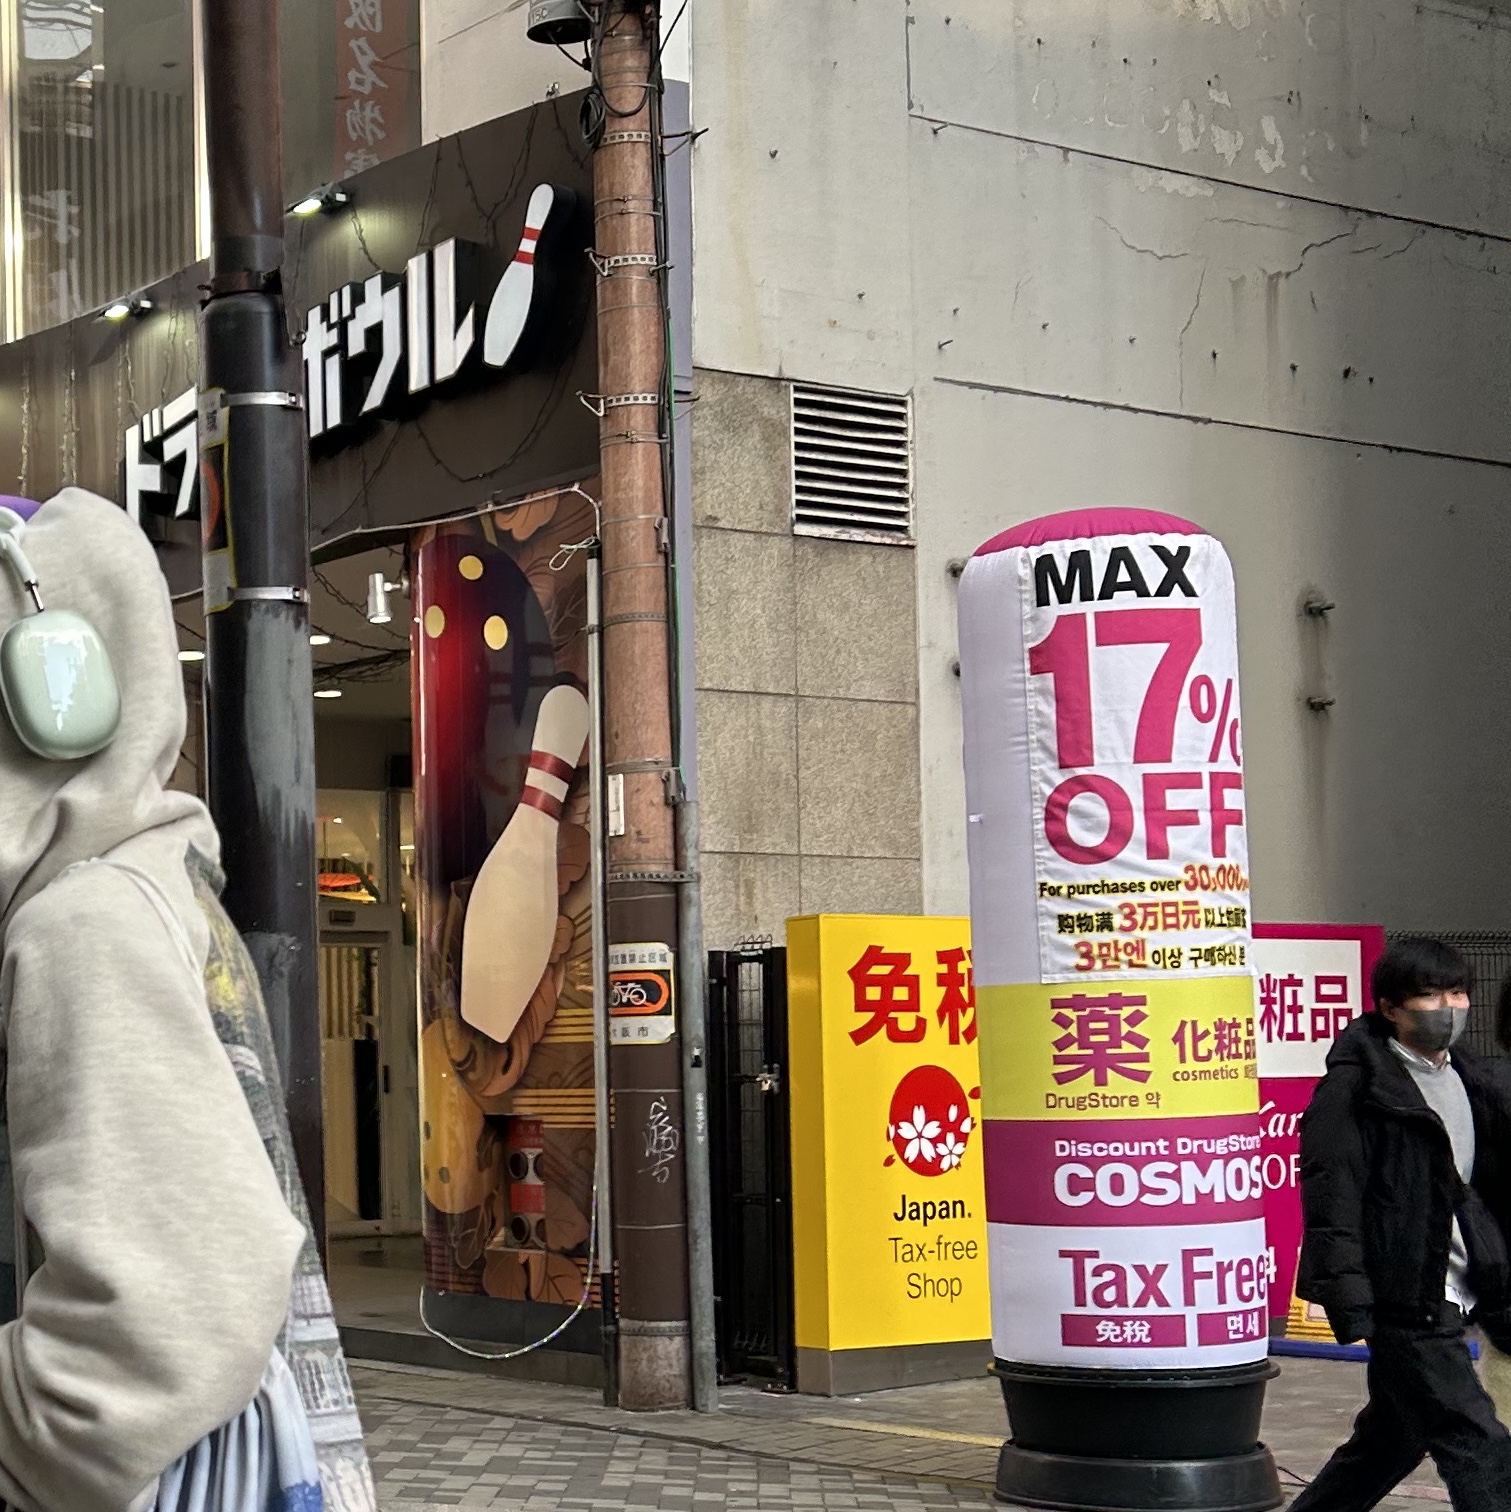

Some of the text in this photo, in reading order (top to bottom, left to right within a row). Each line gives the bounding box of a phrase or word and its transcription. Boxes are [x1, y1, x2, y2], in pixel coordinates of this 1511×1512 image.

[1034, 545, 1200, 608] MAX
[1044, 771, 1244, 866] OFF
[1039, 881, 1063, 897] For
[1067, 879, 1146, 899] purchases
[1150, 879, 1183, 893] over
[1073, 938, 1148, 971] 3만엔
[1151, 948, 1183, 969] 이상
[1050, 991, 1153, 1088] 薬
[1172, 1064, 1239, 1082] cosmetics
[1045, 1092, 1140, 1111] DrugStore
[1145, 1091, 1162, 1109] 약
[1054, 1132, 1261, 1158] Discount DrugStore
[1053, 1156, 1263, 1207] COSMOS
[893, 1194, 973, 1228] Japan.
[888, 1234, 979, 1264] Tax-free
[906, 1271, 963, 1303] Shop
[1058, 1248, 1171, 1309] Tax
[1181, 1246, 1266, 1308] Free
[1226, 1311, 1260, 1340] 면세
